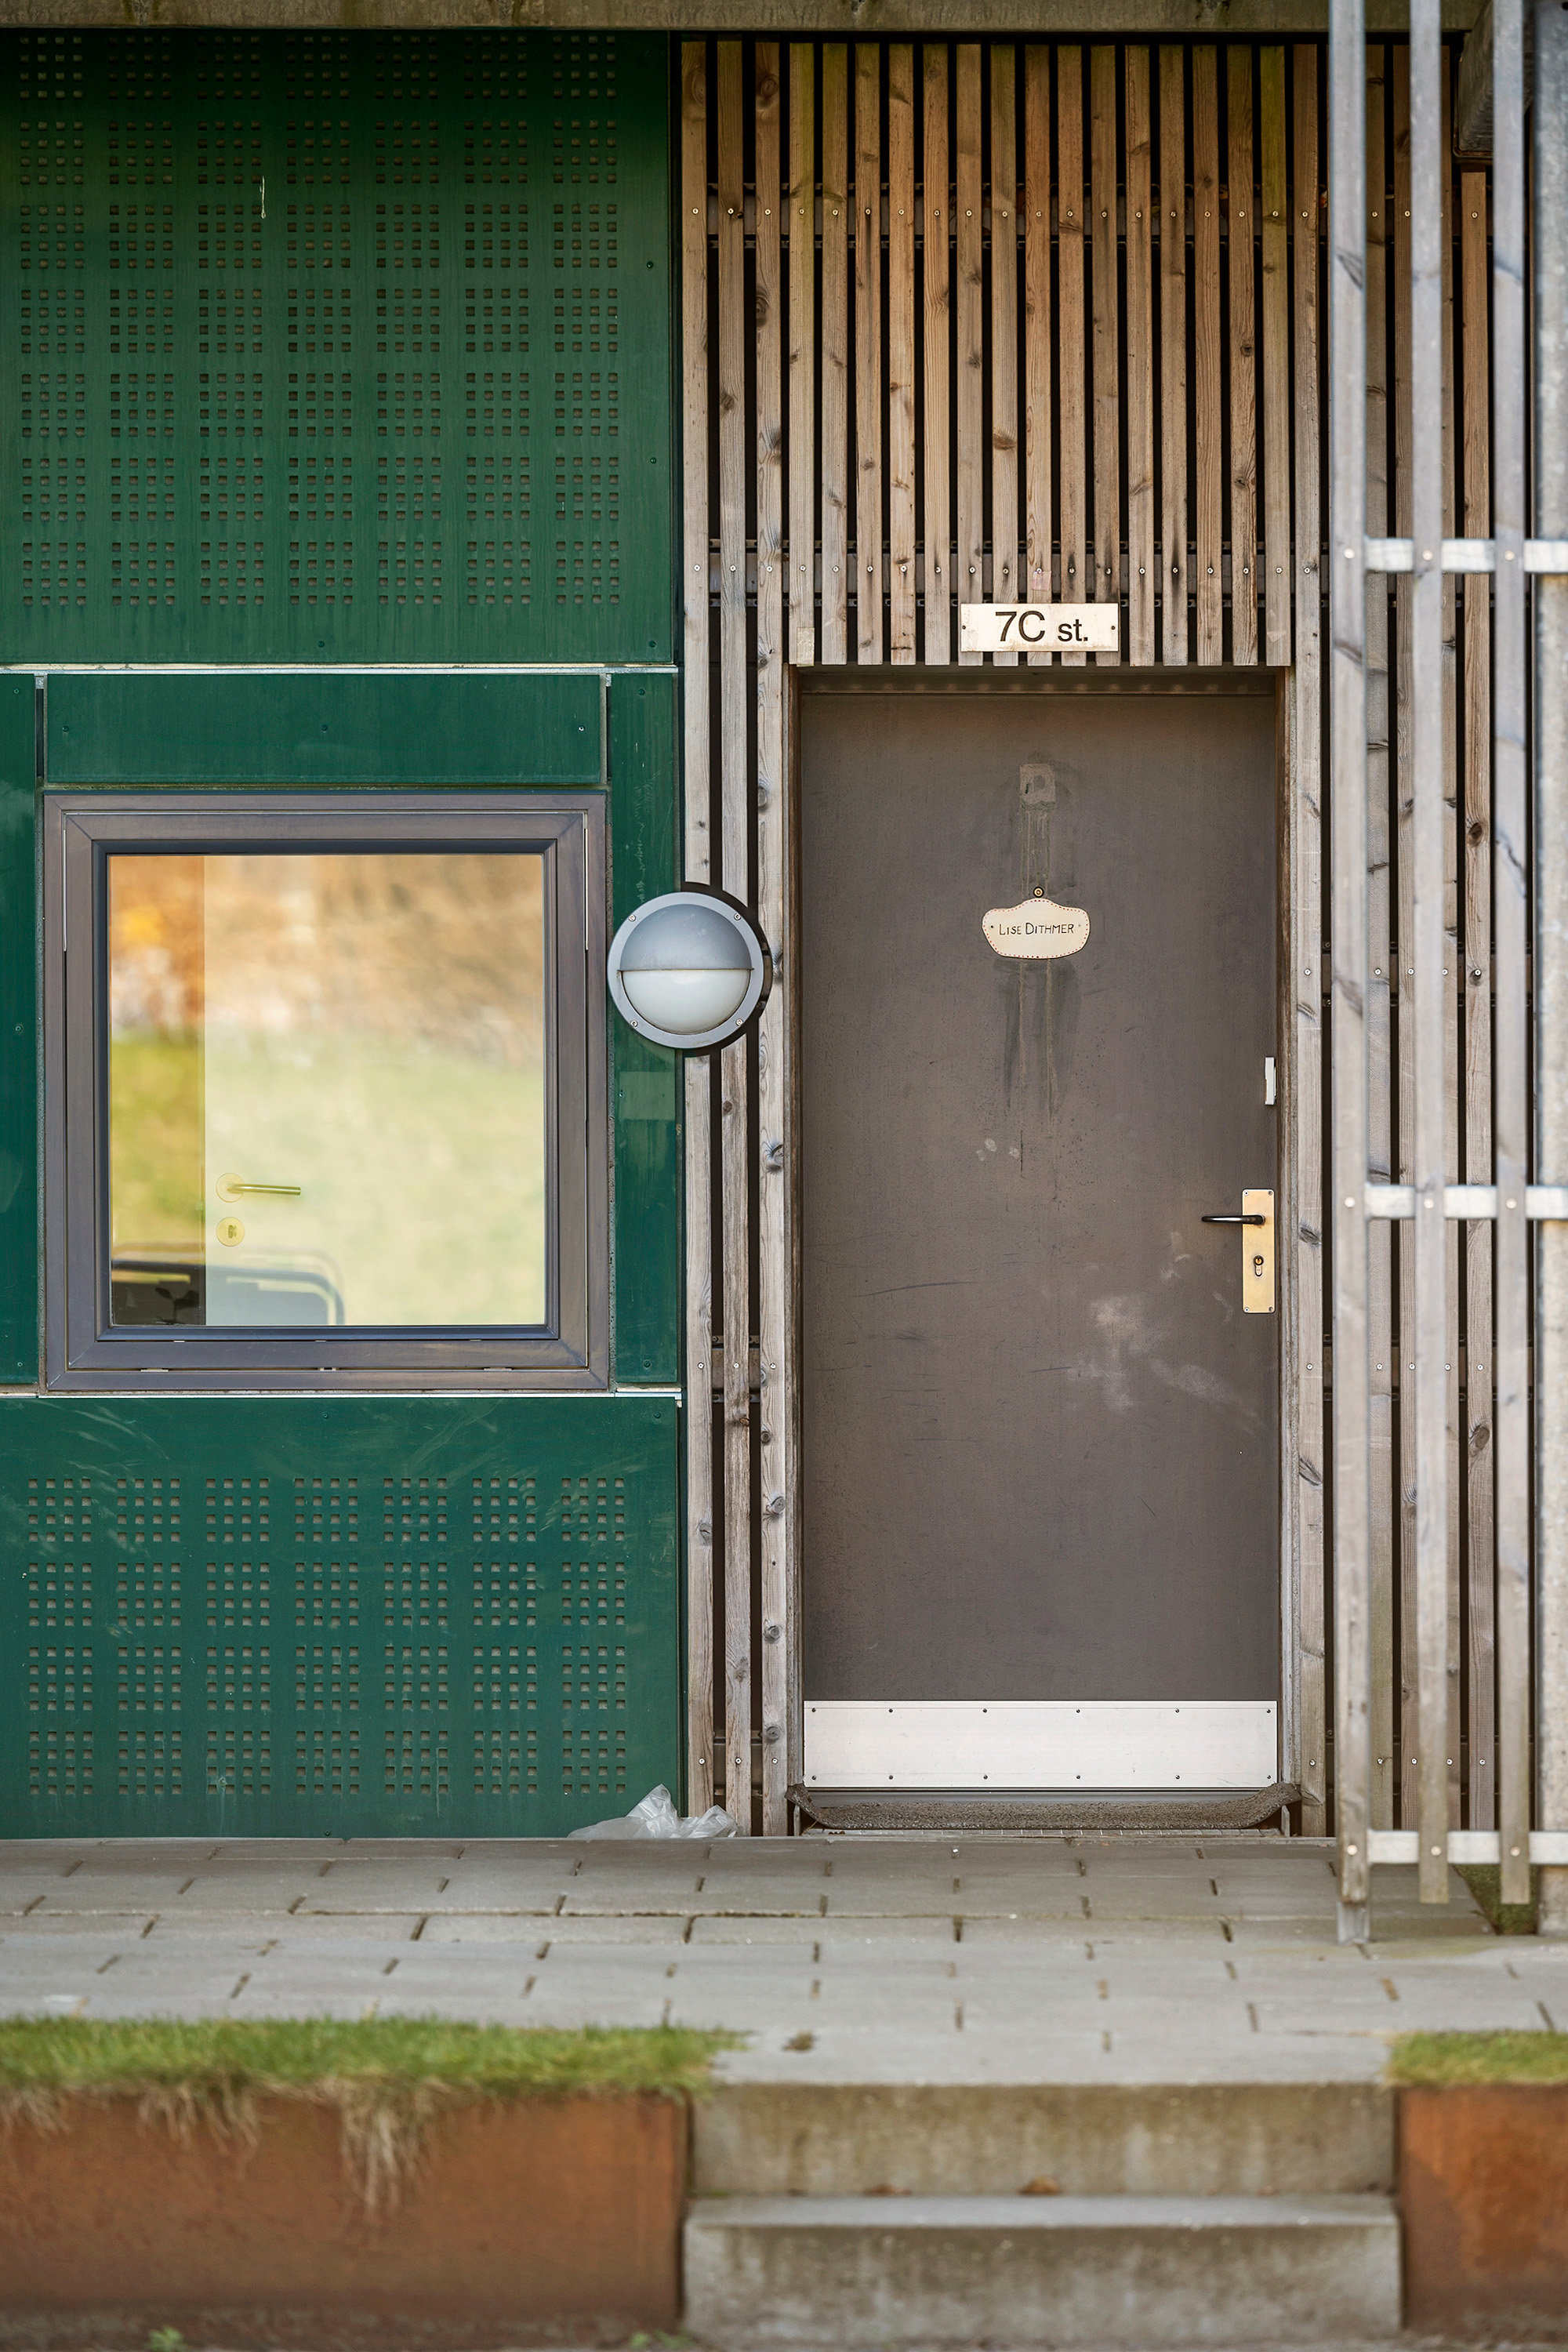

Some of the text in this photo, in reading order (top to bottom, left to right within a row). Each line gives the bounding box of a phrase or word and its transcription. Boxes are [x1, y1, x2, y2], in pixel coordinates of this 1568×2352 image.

[995, 611, 1088, 642] 7C st.
[999, 922, 1074, 935] LISE DITHMER
